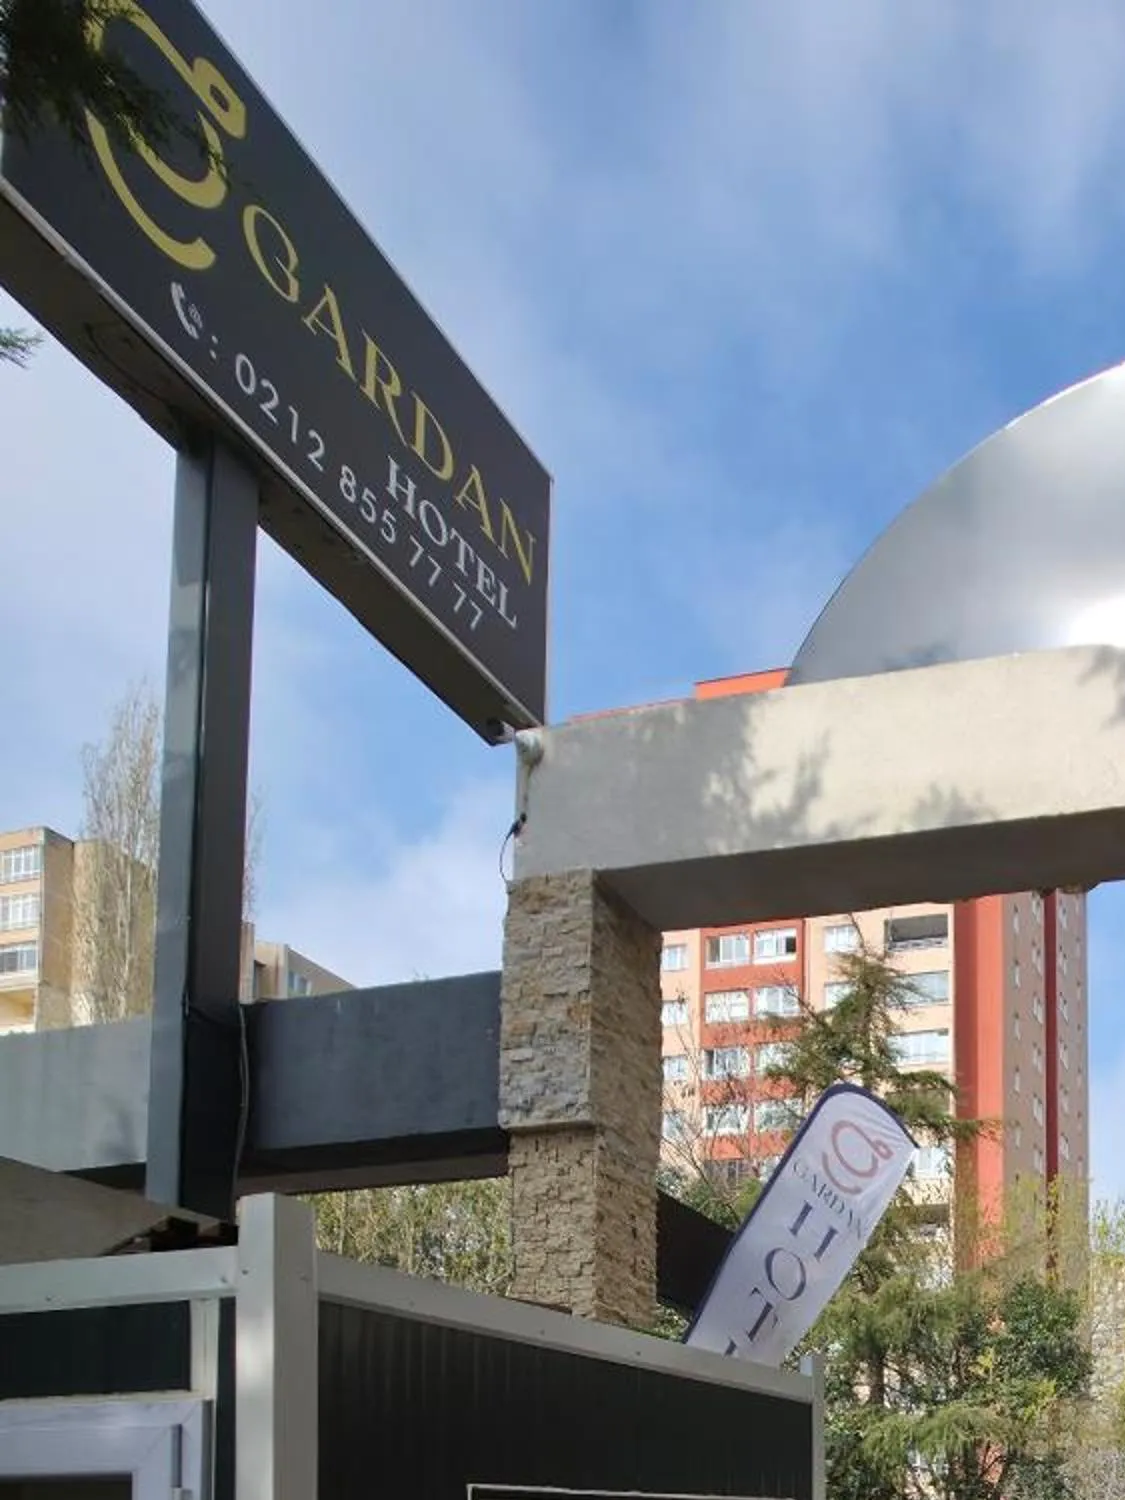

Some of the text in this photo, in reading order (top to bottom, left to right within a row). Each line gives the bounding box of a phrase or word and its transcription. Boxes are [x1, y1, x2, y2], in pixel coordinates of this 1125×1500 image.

[235, 352, 326, 472] 0212
[338, 464, 397, 545] 855
[408, 534, 443, 588] 77
[452, 581, 484, 631] 77
[242, 204, 536, 587] GARDAN
[386, 454, 518, 630] HOTEL
[724, 1199, 838, 1358] HOT
